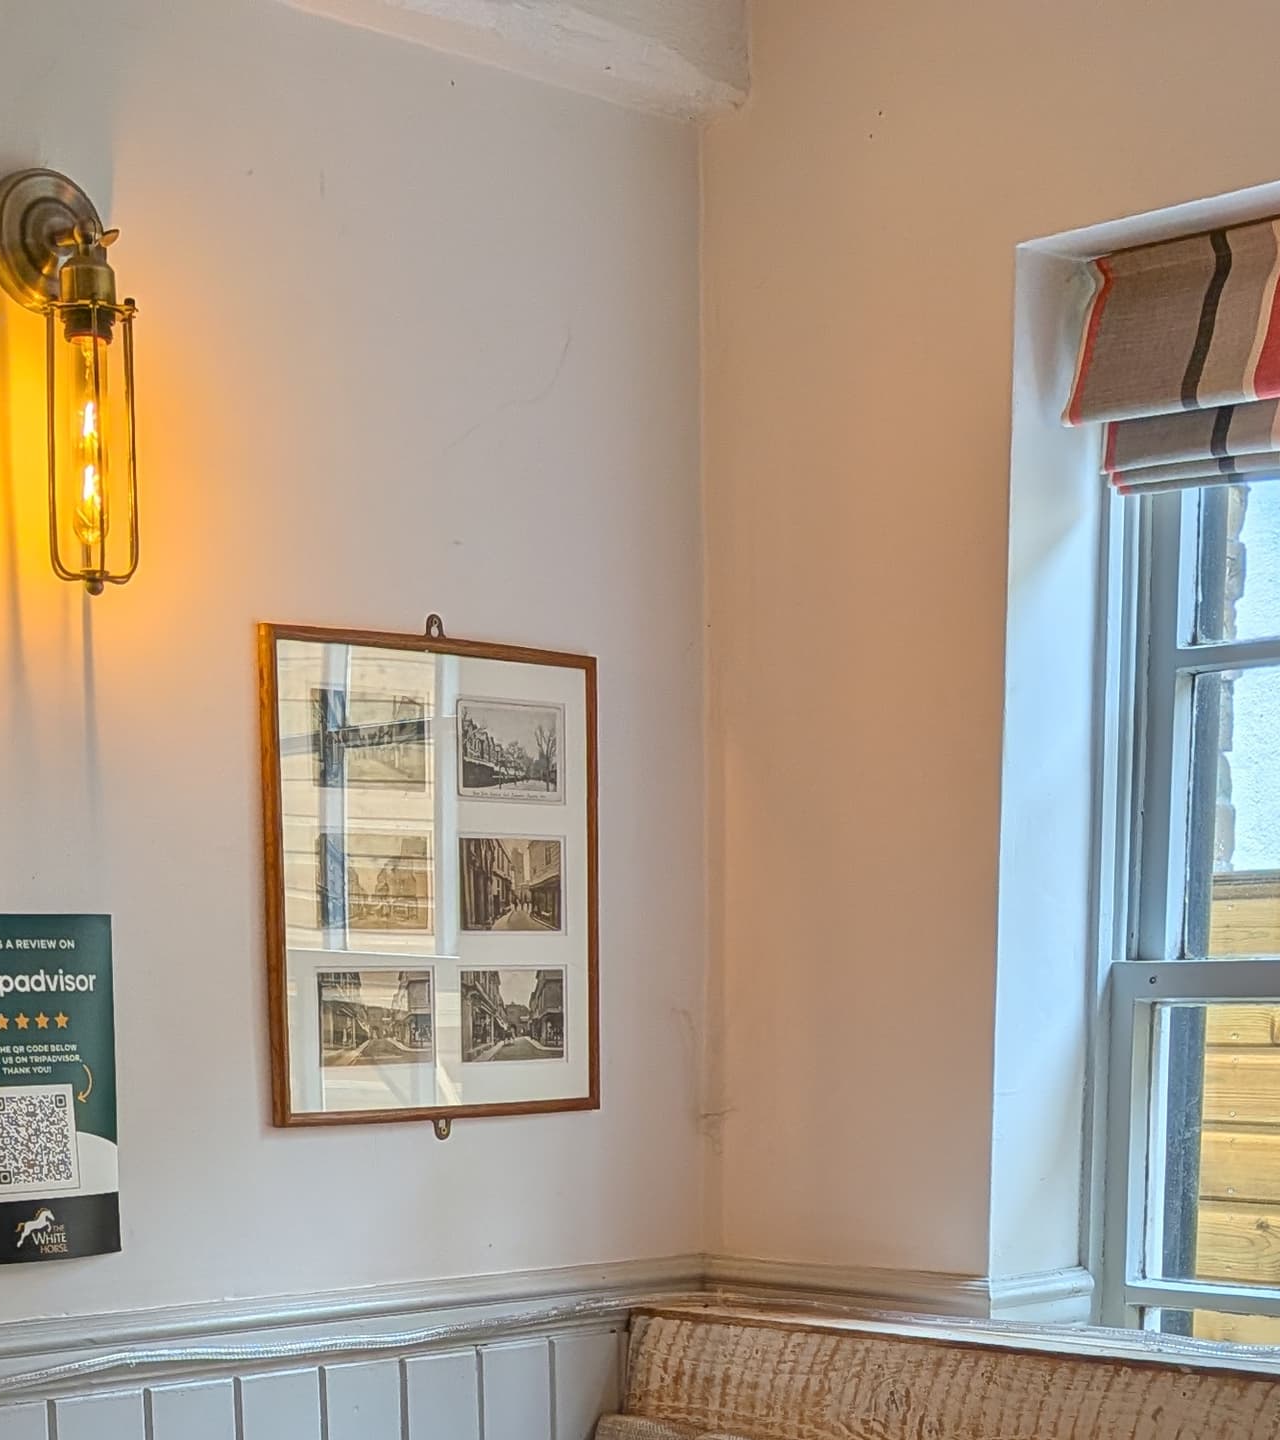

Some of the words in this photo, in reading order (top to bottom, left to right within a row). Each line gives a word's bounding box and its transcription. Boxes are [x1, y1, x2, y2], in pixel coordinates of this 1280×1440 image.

[5, 939, 14, 949] A
[15, 939, 57, 949] REVIEW
[58, 939, 75, 949] ON
[13, 1045, 25, 1054] QR
[26, 1044, 49, 1053] CODE
[50, 1044, 77, 1052] BELOW
[2, 1056, 14, 1064] US
[15, 1055, 28, 1063] ON
[2, 1067, 31, 1075] THANK
[51, 1224, 64, 1232] THE
[31, 1231, 67, 1246] WHITE
[40, 1243, 68, 1254] HORSE
